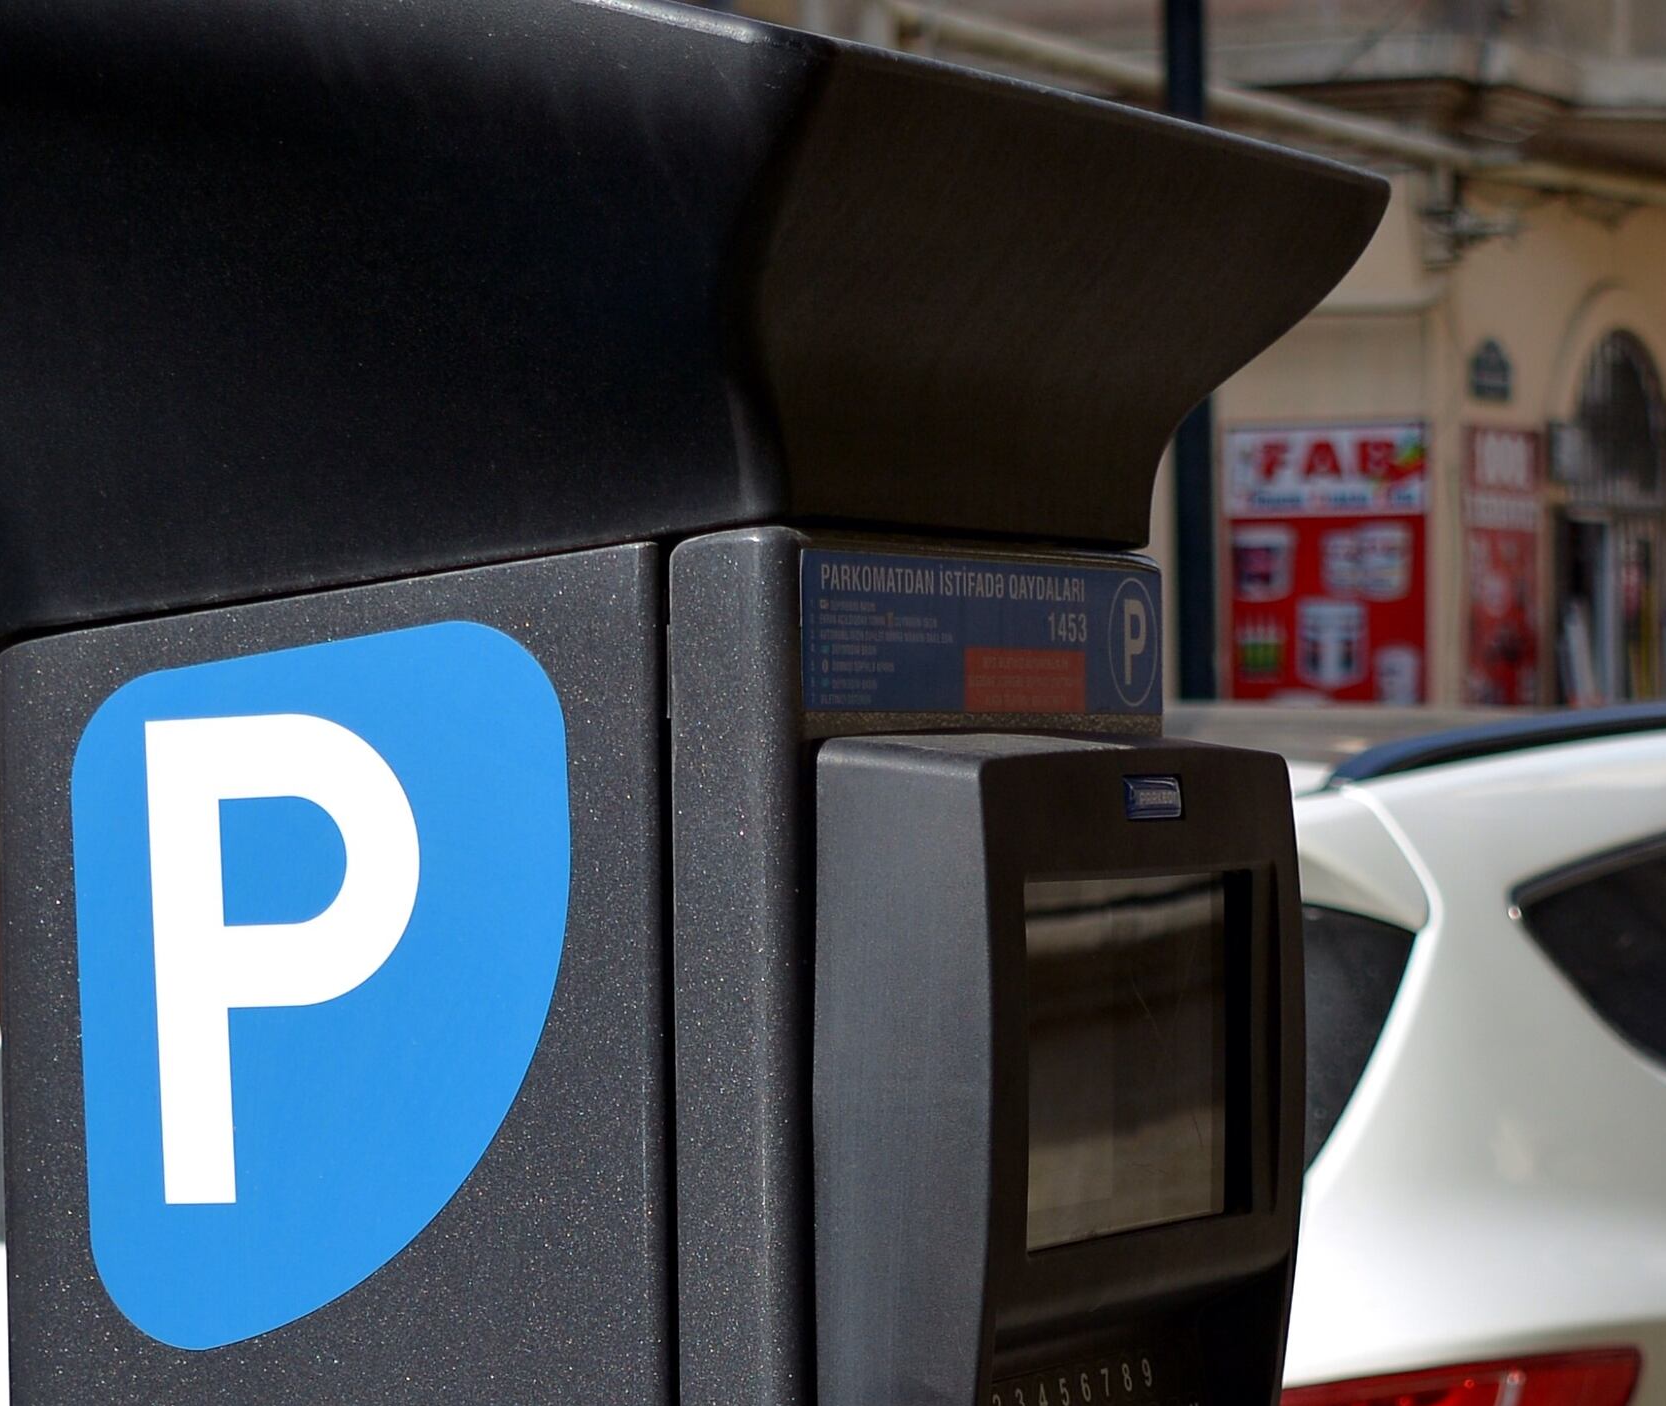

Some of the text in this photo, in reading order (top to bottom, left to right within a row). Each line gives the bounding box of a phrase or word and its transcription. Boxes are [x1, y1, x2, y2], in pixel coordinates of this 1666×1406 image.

[820, 563, 1085, 602] PARKOMATDAN İSTİFADƏ QAYDALARI
[1048, 612, 1087, 642] 1453
[1124, 599, 1146, 684] P
[145, 713, 420, 1204] P
[1059, 1377, 1070, 1406] 5
[1080, 1373, 1091, 1402] 6
[1101, 1368, 1110, 1396] 7
[1122, 1363, 1132, 1391] 8
[1141, 1358, 1152, 1387] 9
